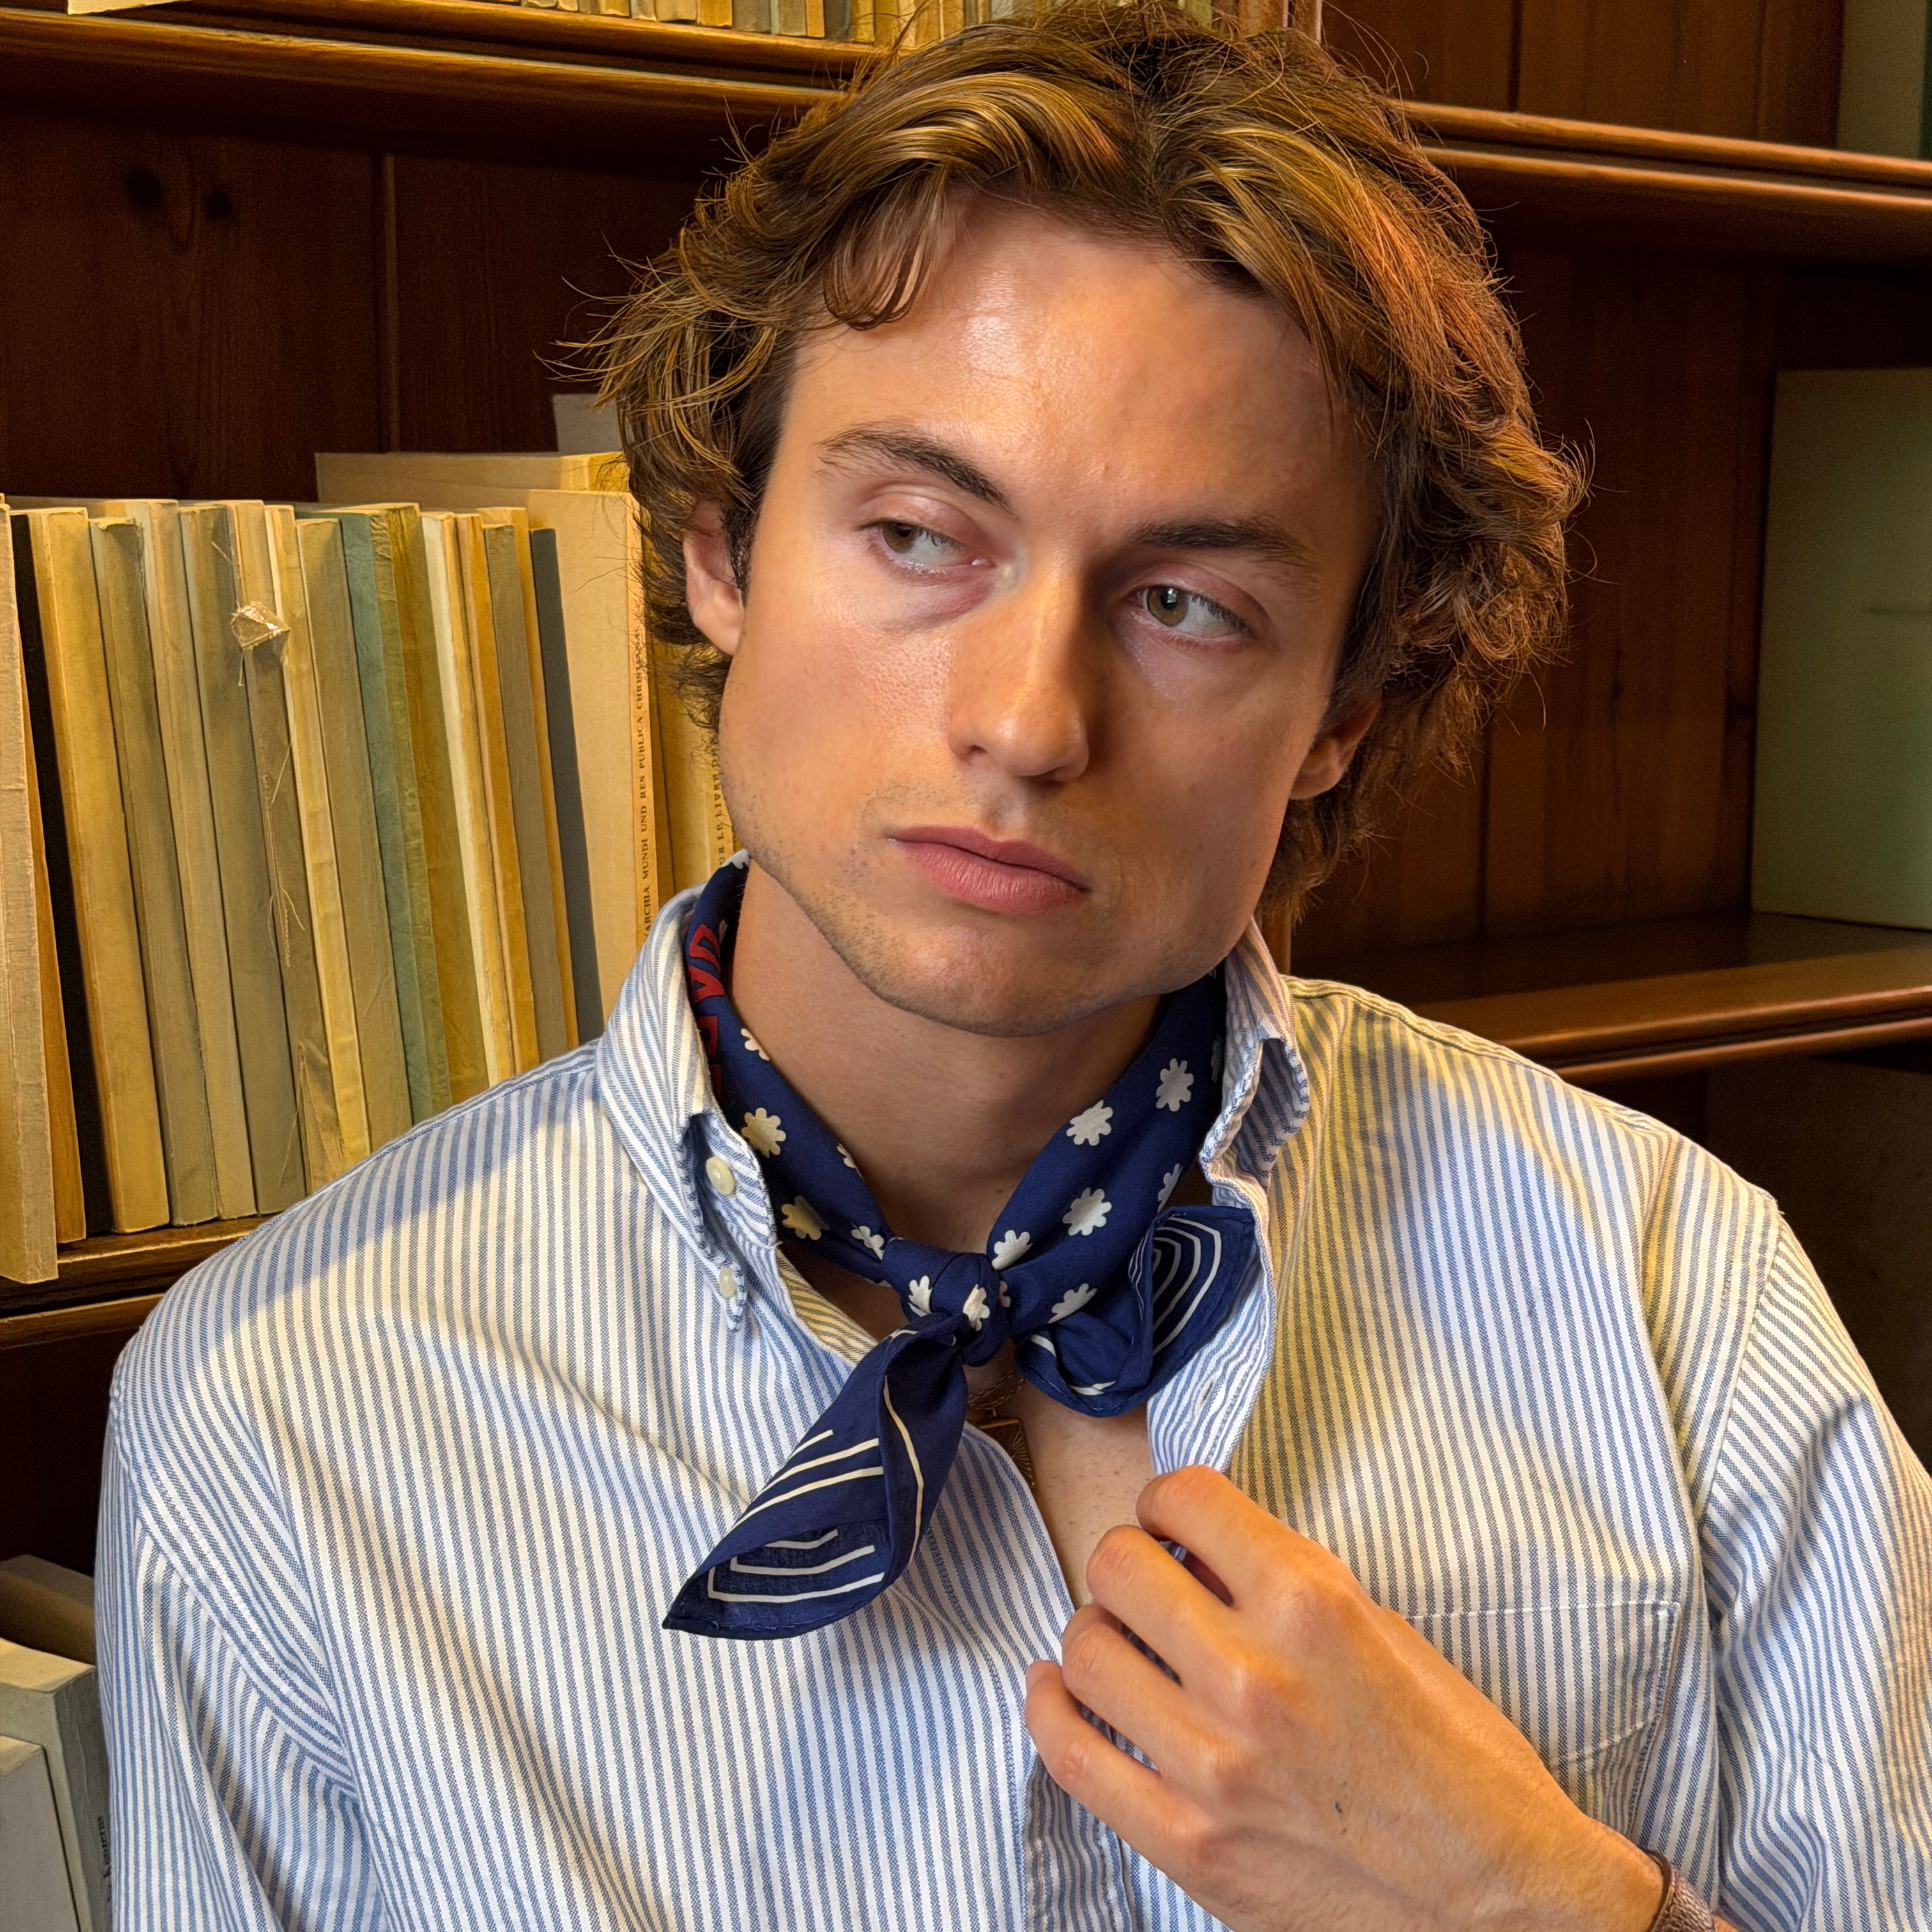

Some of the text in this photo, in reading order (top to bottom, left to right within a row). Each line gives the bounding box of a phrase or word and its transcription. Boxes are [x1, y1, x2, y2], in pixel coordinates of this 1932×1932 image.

[636, 716, 645, 769] PUBLICA
[639, 775, 647, 799] RES
[641, 838, 650, 880] MUNDI
[643, 886, 651, 937] ARCHIA
